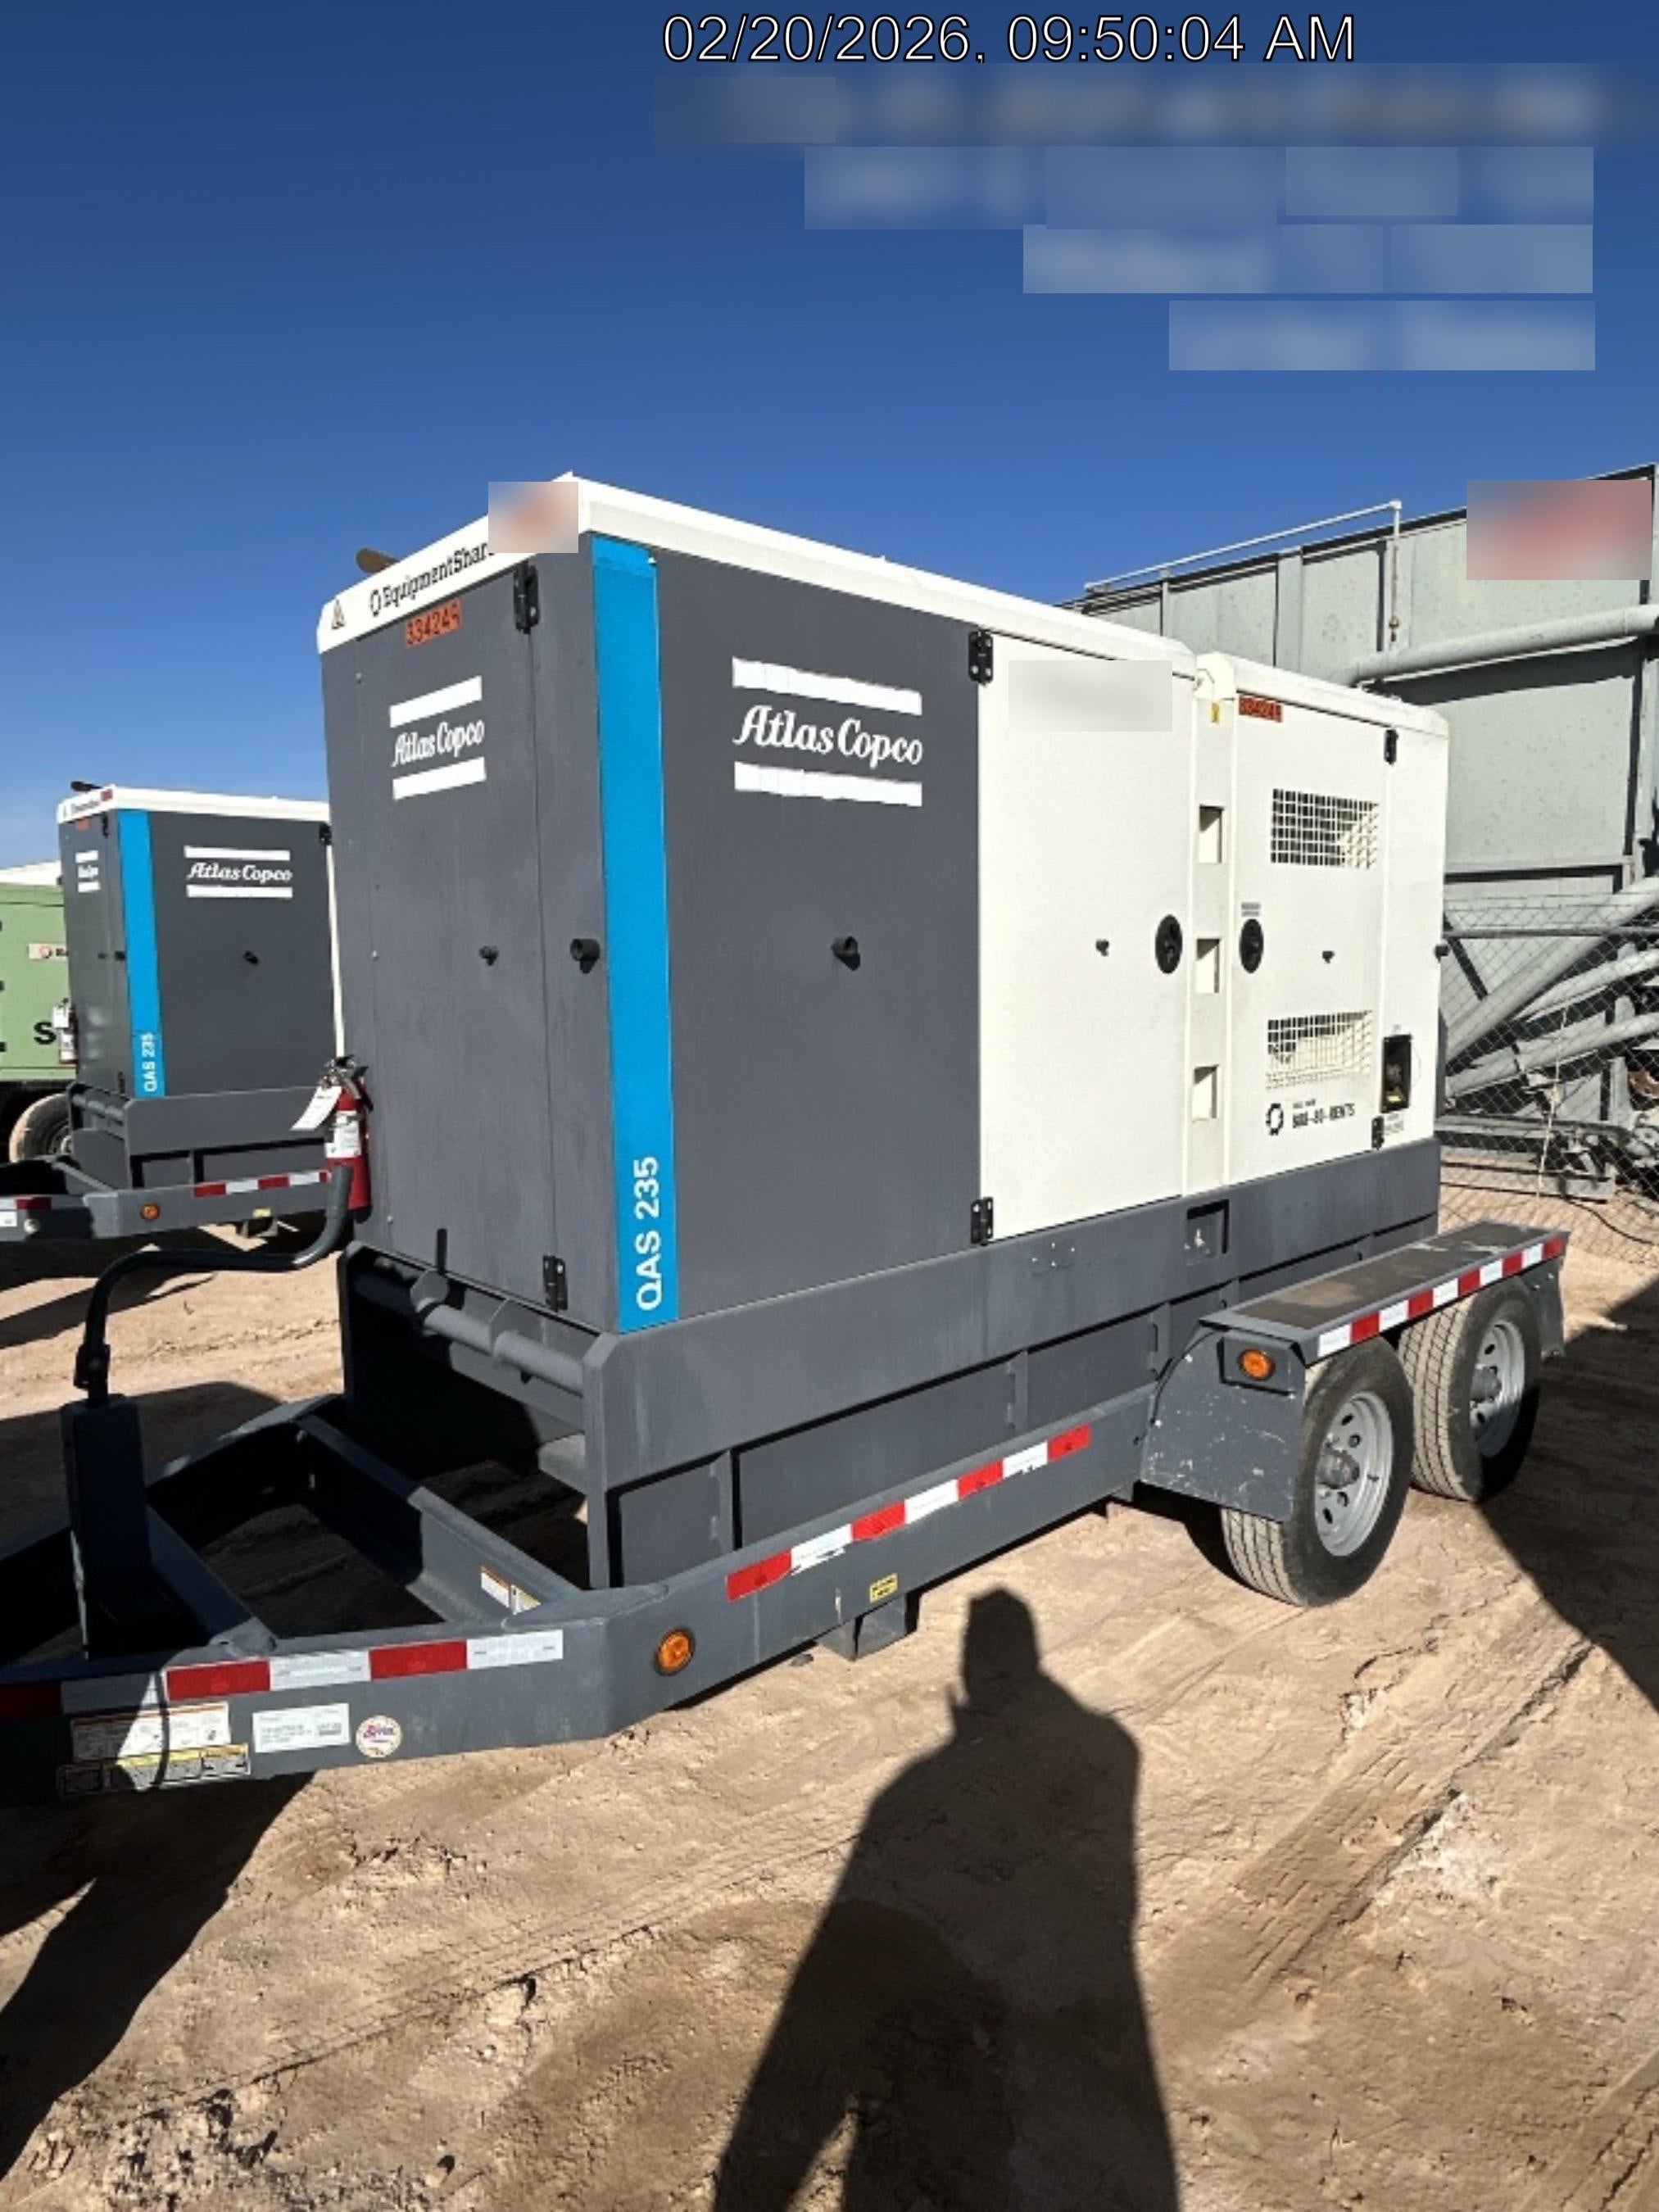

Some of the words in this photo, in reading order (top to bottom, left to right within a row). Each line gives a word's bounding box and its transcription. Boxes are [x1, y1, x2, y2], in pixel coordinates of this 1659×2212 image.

[383, 542, 494, 608] EquipmentShar
[392, 732, 435, 767] Atlas
[437, 719, 485, 757] Copco
[732, 705, 834, 754] Atlas
[837, 718, 922, 768] Copco
[186, 862, 241, 880] Atlas
[242, 864, 292, 884] Copco
[632, 1156, 660, 1220] 235
[634, 1230, 662, 1311] QAS
